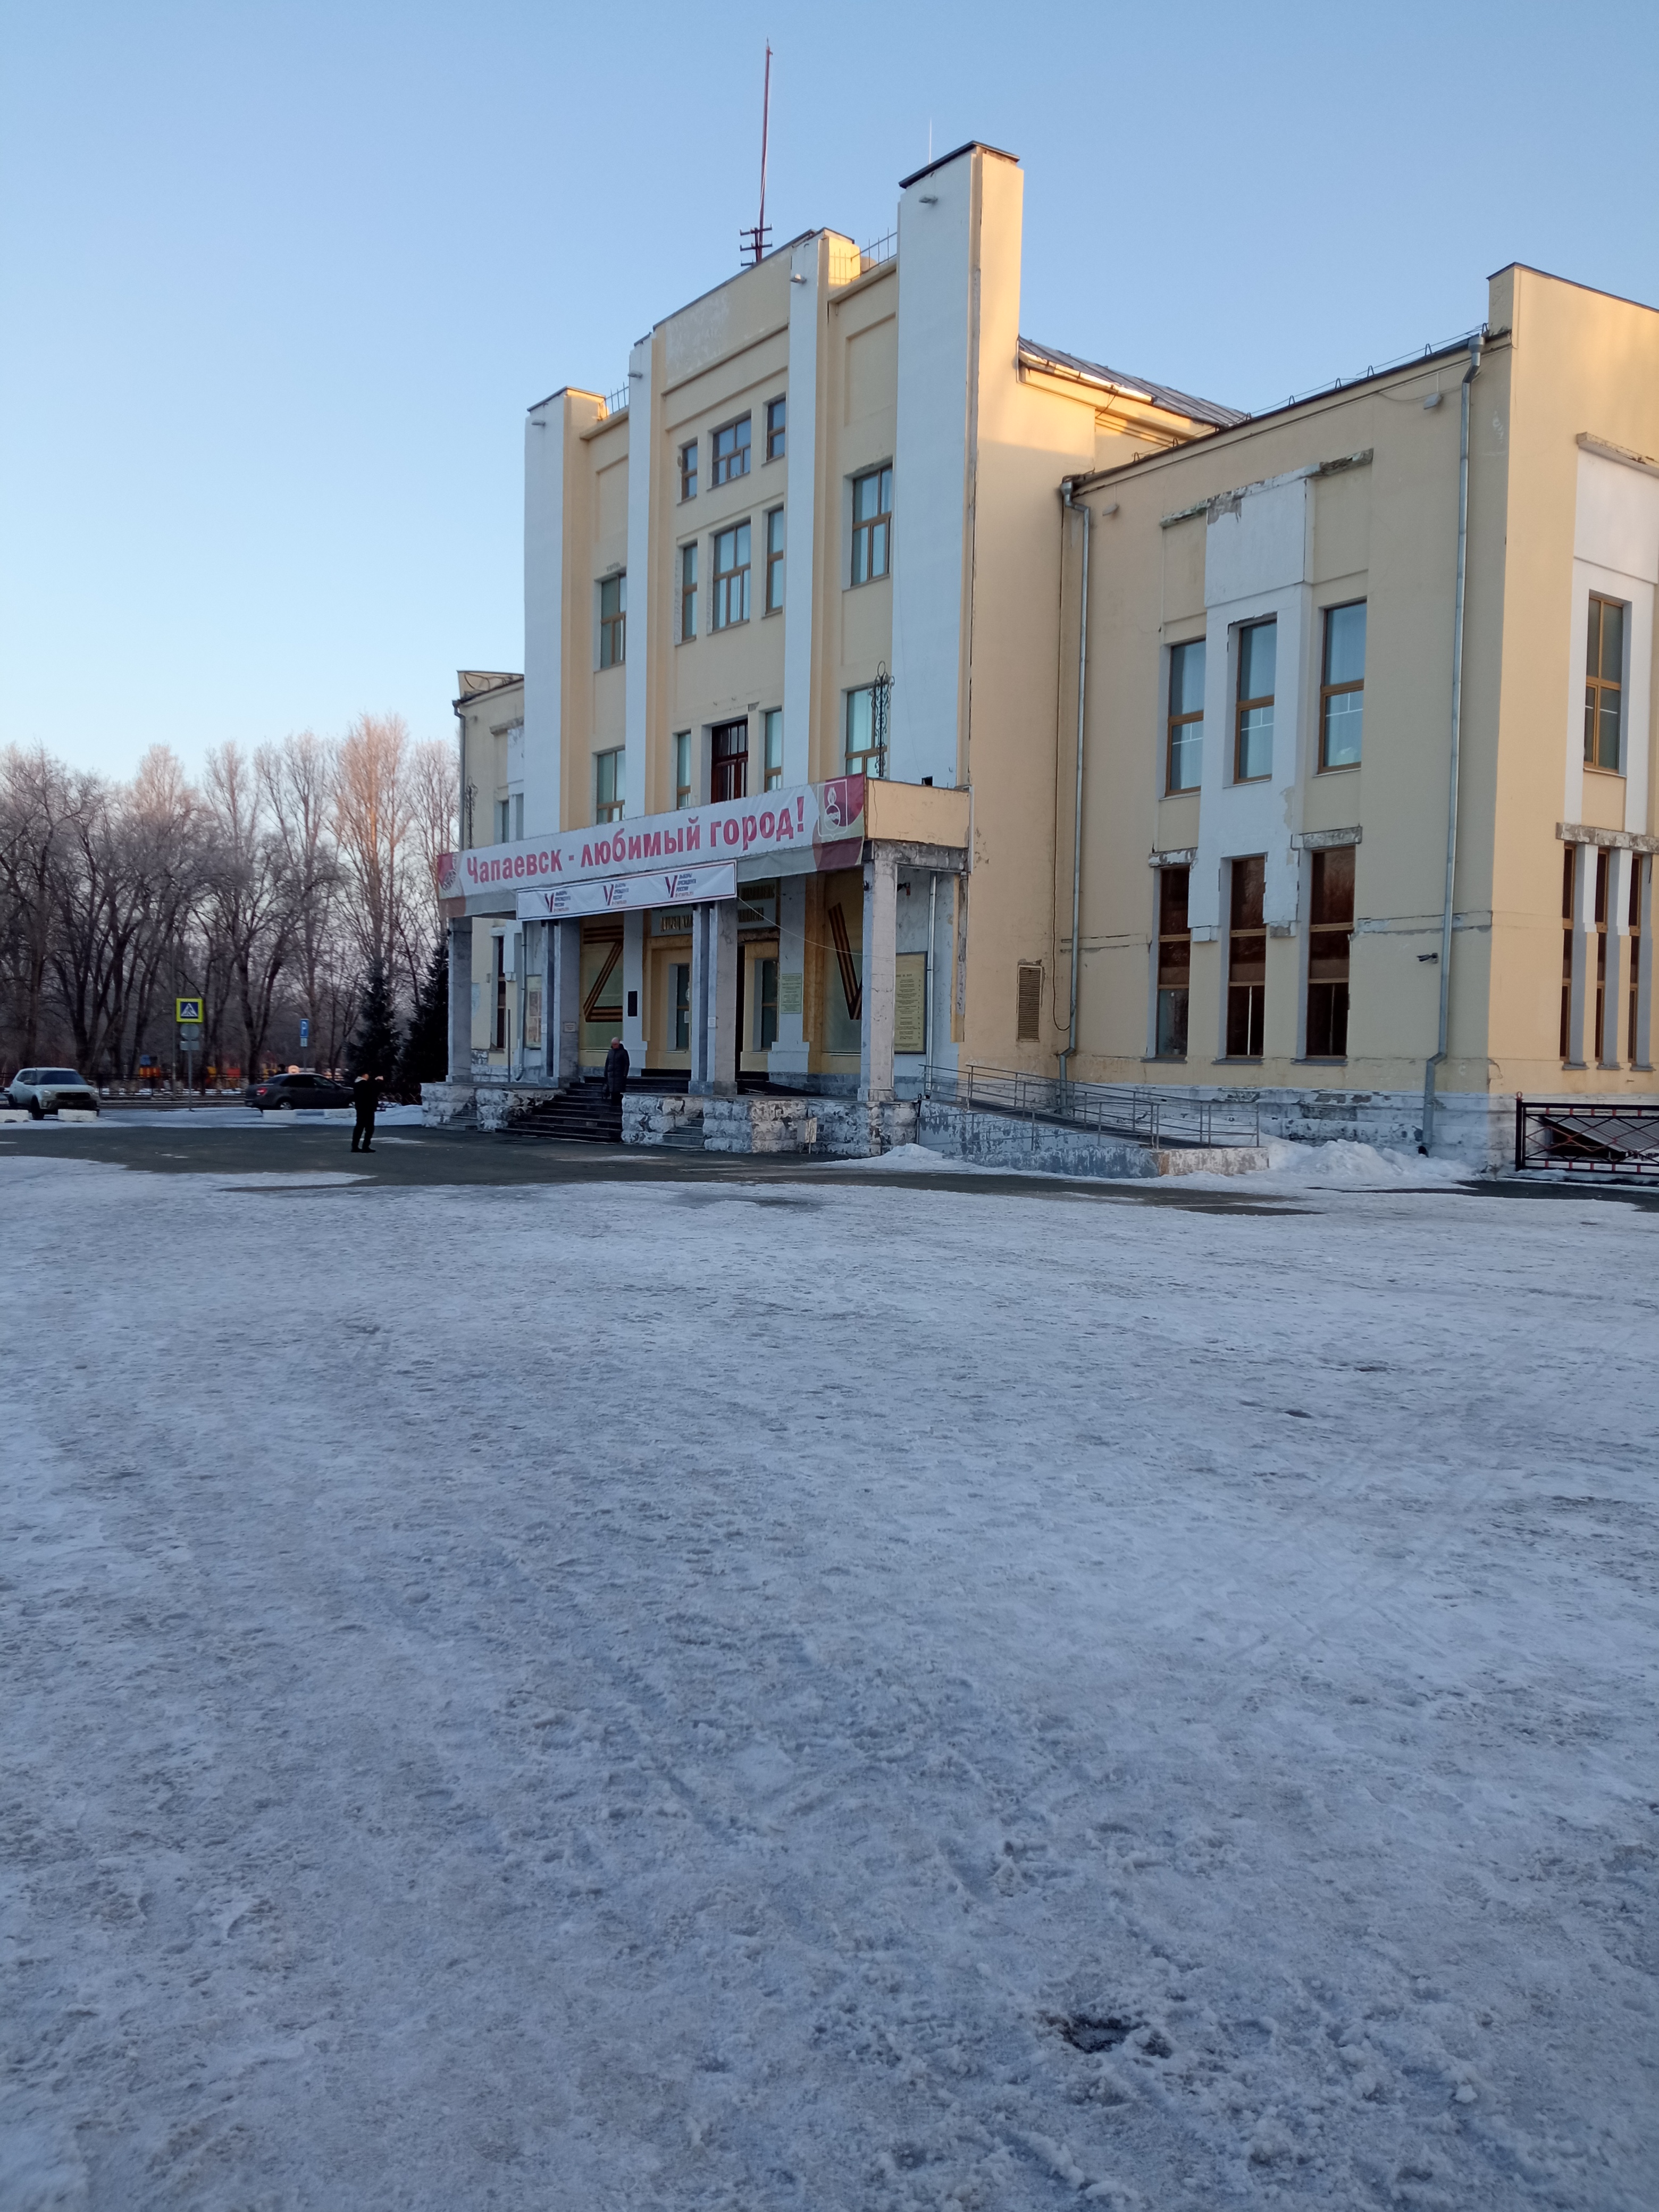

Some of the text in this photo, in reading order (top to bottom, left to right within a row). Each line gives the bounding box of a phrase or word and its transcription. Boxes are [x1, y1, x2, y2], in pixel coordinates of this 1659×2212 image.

[467, 849, 563, 884] Чапаевск
[581, 816, 700, 867] любимый
[710, 796, 805, 851] город!
